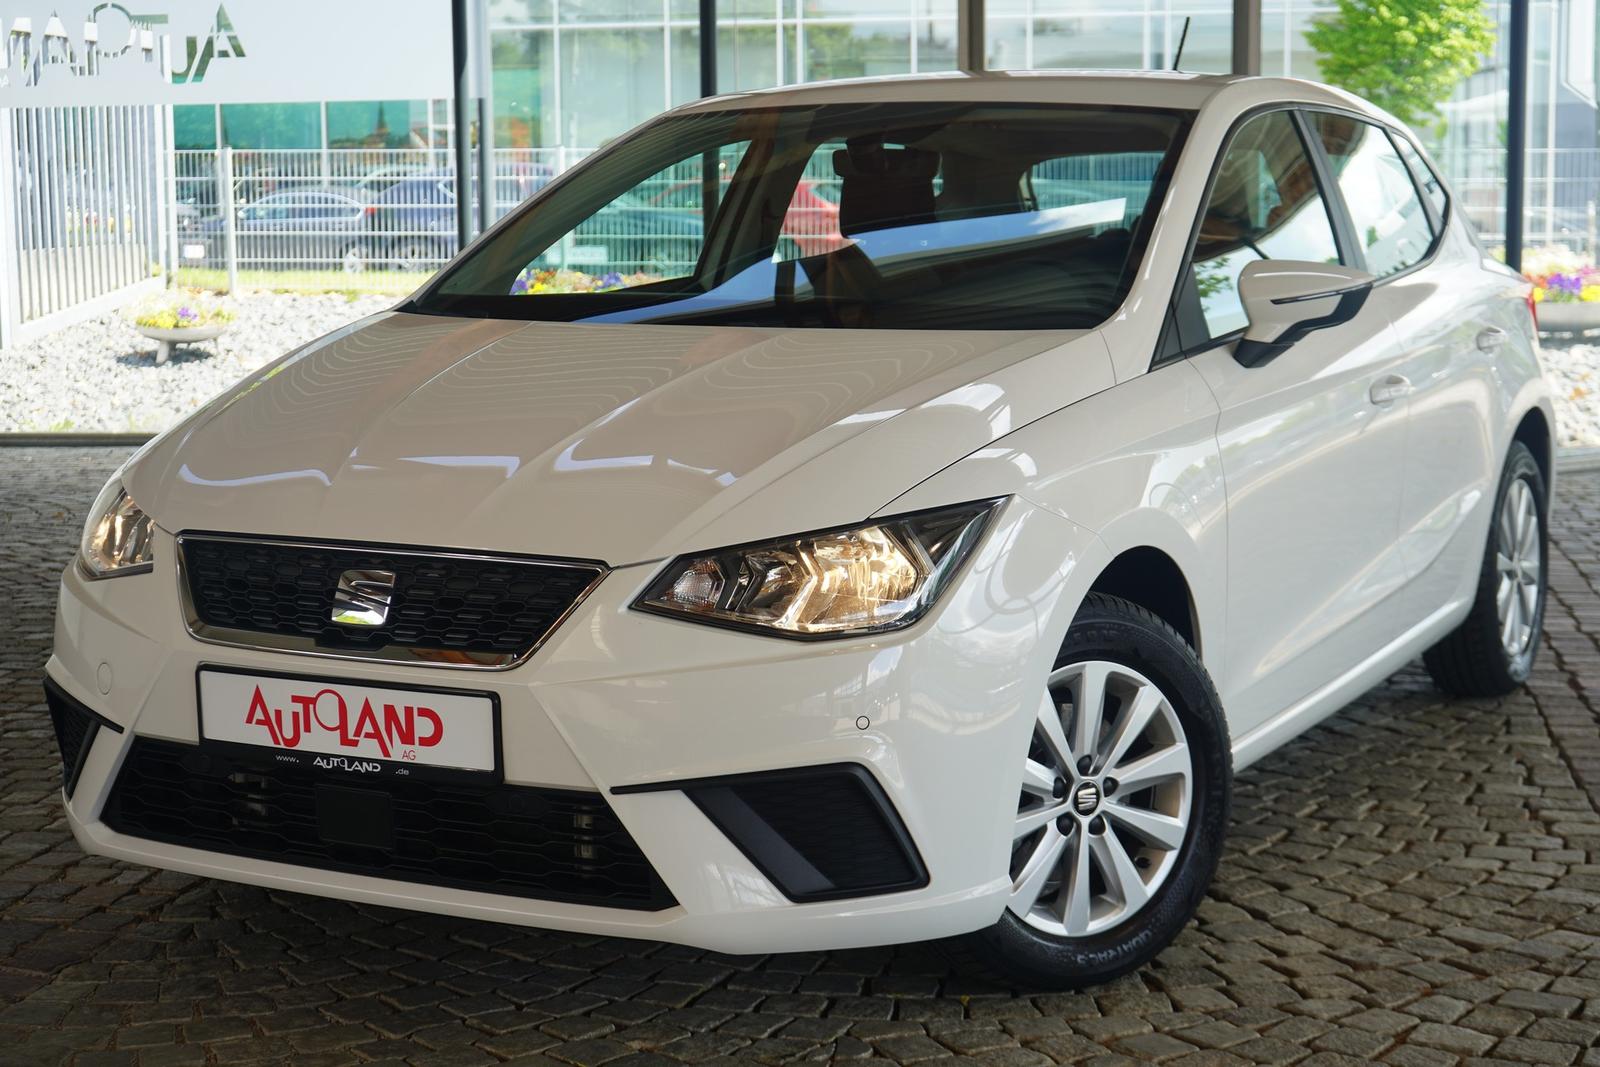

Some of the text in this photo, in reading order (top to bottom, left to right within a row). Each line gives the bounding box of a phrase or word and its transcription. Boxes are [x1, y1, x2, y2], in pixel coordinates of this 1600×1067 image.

[245, 684, 444, 758] AUTOLAND
[401, 749, 417, 761] AG
[312, 756, 382, 773] AUTOLAND
